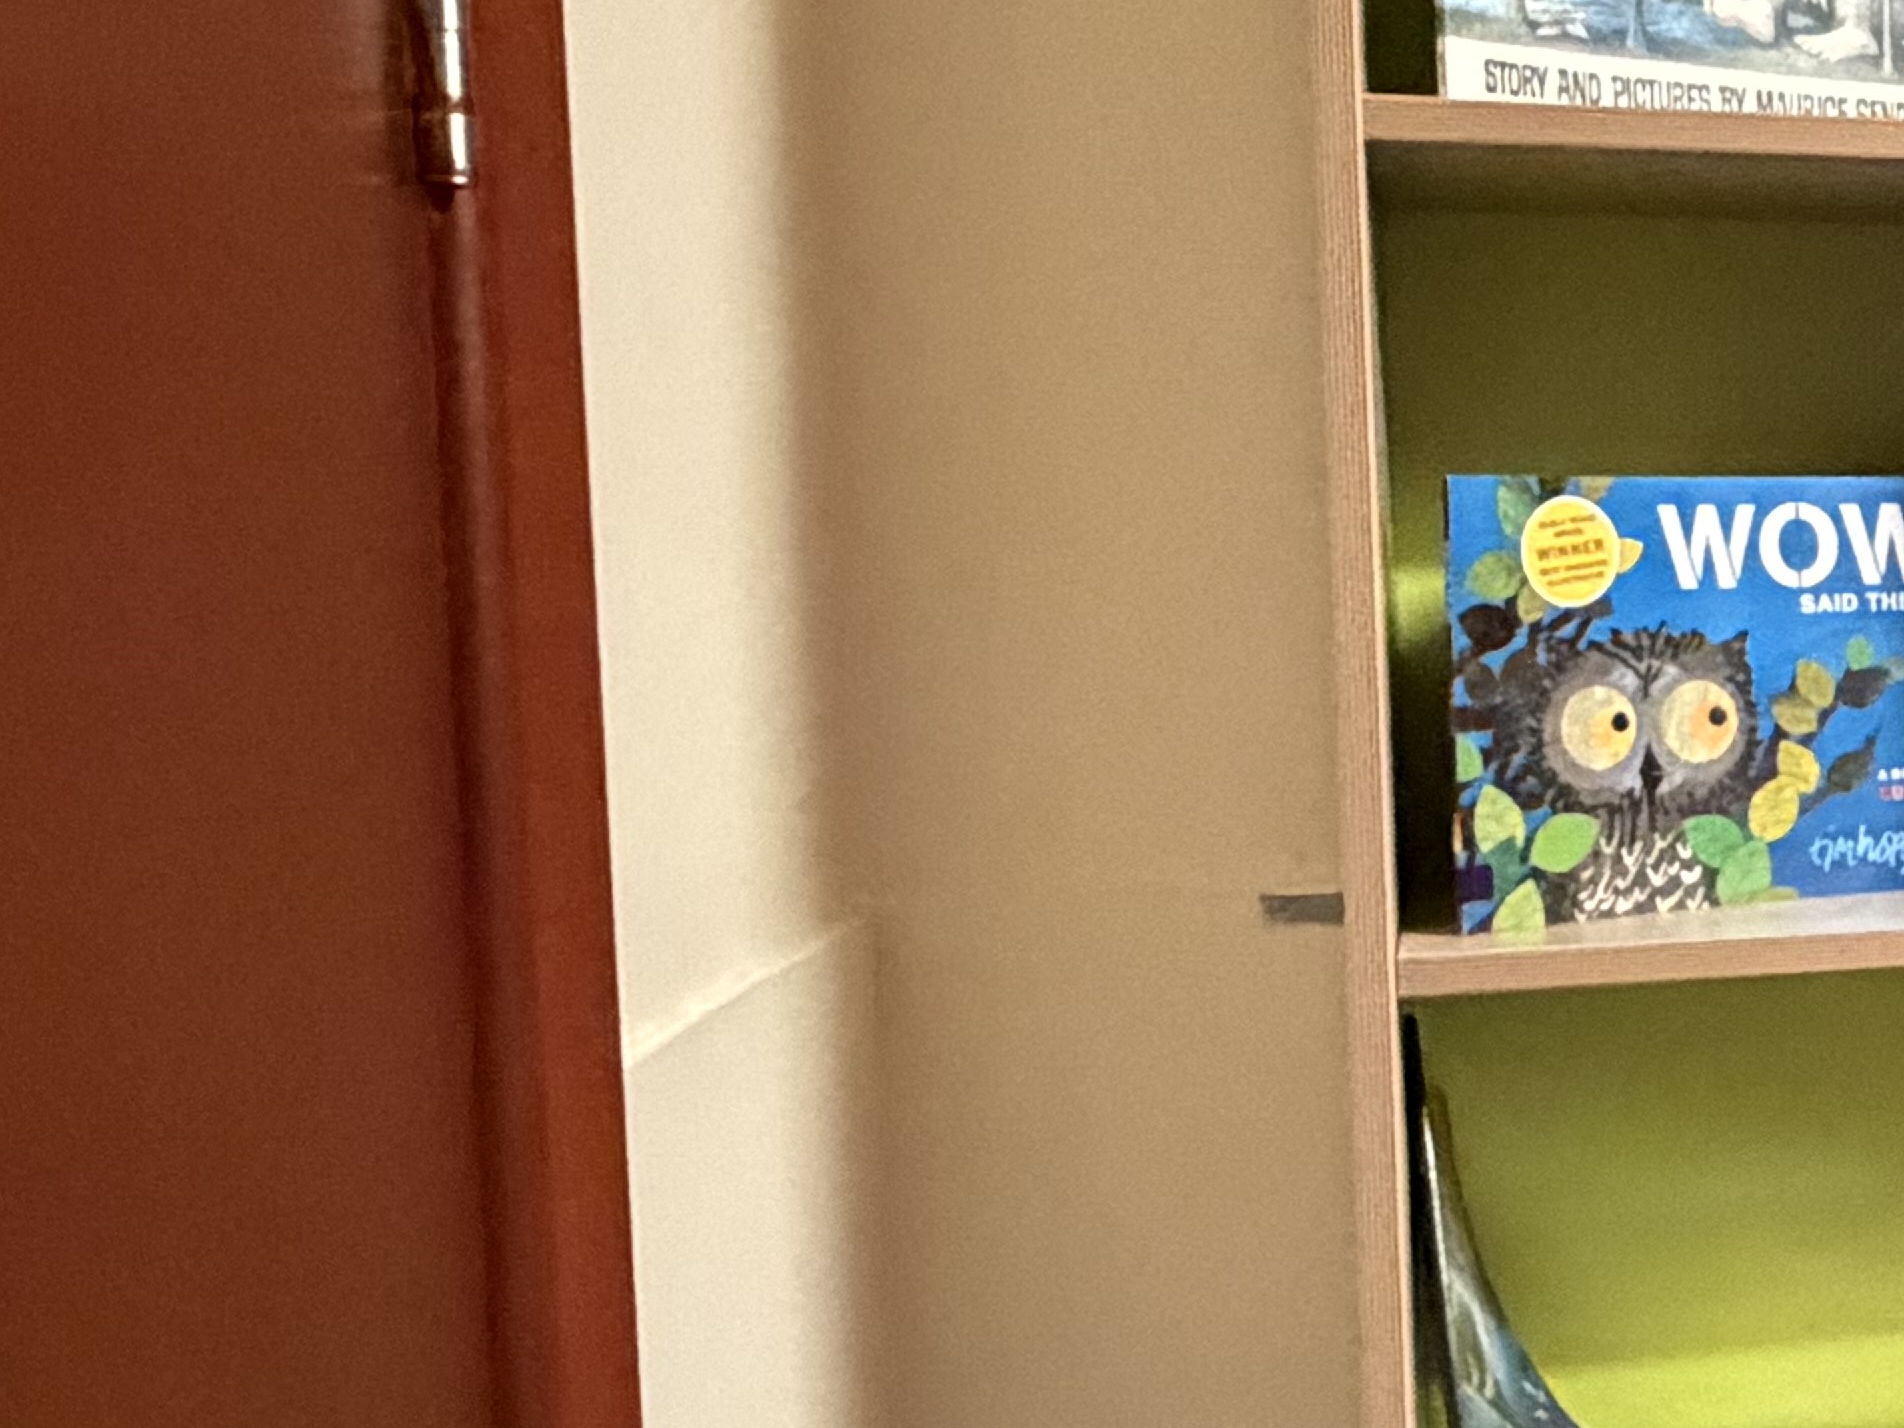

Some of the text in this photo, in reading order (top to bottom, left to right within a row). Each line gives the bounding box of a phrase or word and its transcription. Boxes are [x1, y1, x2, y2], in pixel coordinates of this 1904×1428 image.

[1483, 58, 1548, 100] STORY
[1557, 68, 1601, 107] AND
[1611, 75, 1711, 113] PICTURES
[1718, 85, 1747, 114] BY
[1800, 592, 1859, 614] SAID
